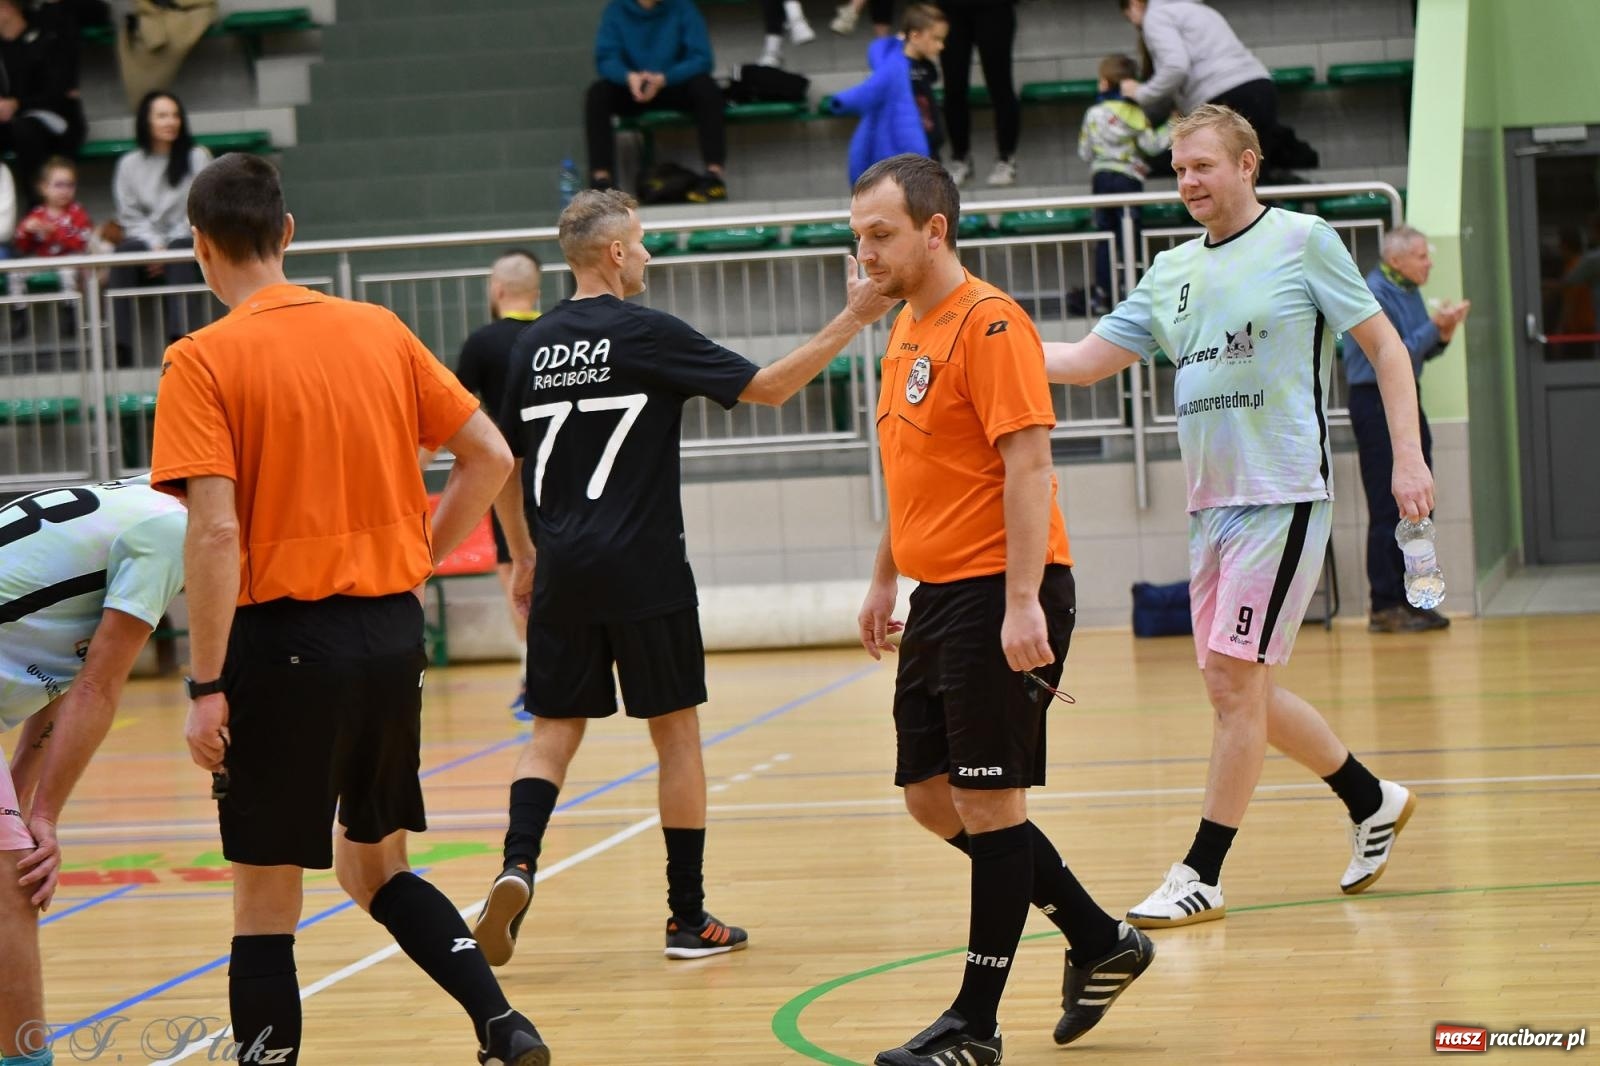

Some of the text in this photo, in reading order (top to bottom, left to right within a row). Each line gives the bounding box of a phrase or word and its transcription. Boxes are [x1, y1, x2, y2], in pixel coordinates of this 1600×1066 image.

[1178, 283, 1190, 313] 9
[532, 338, 611, 372] ODRA
[533, 366, 611, 390] RACIBÓRZ
[520, 393, 648, 507] 77
[1236, 606, 1253, 636] 9
